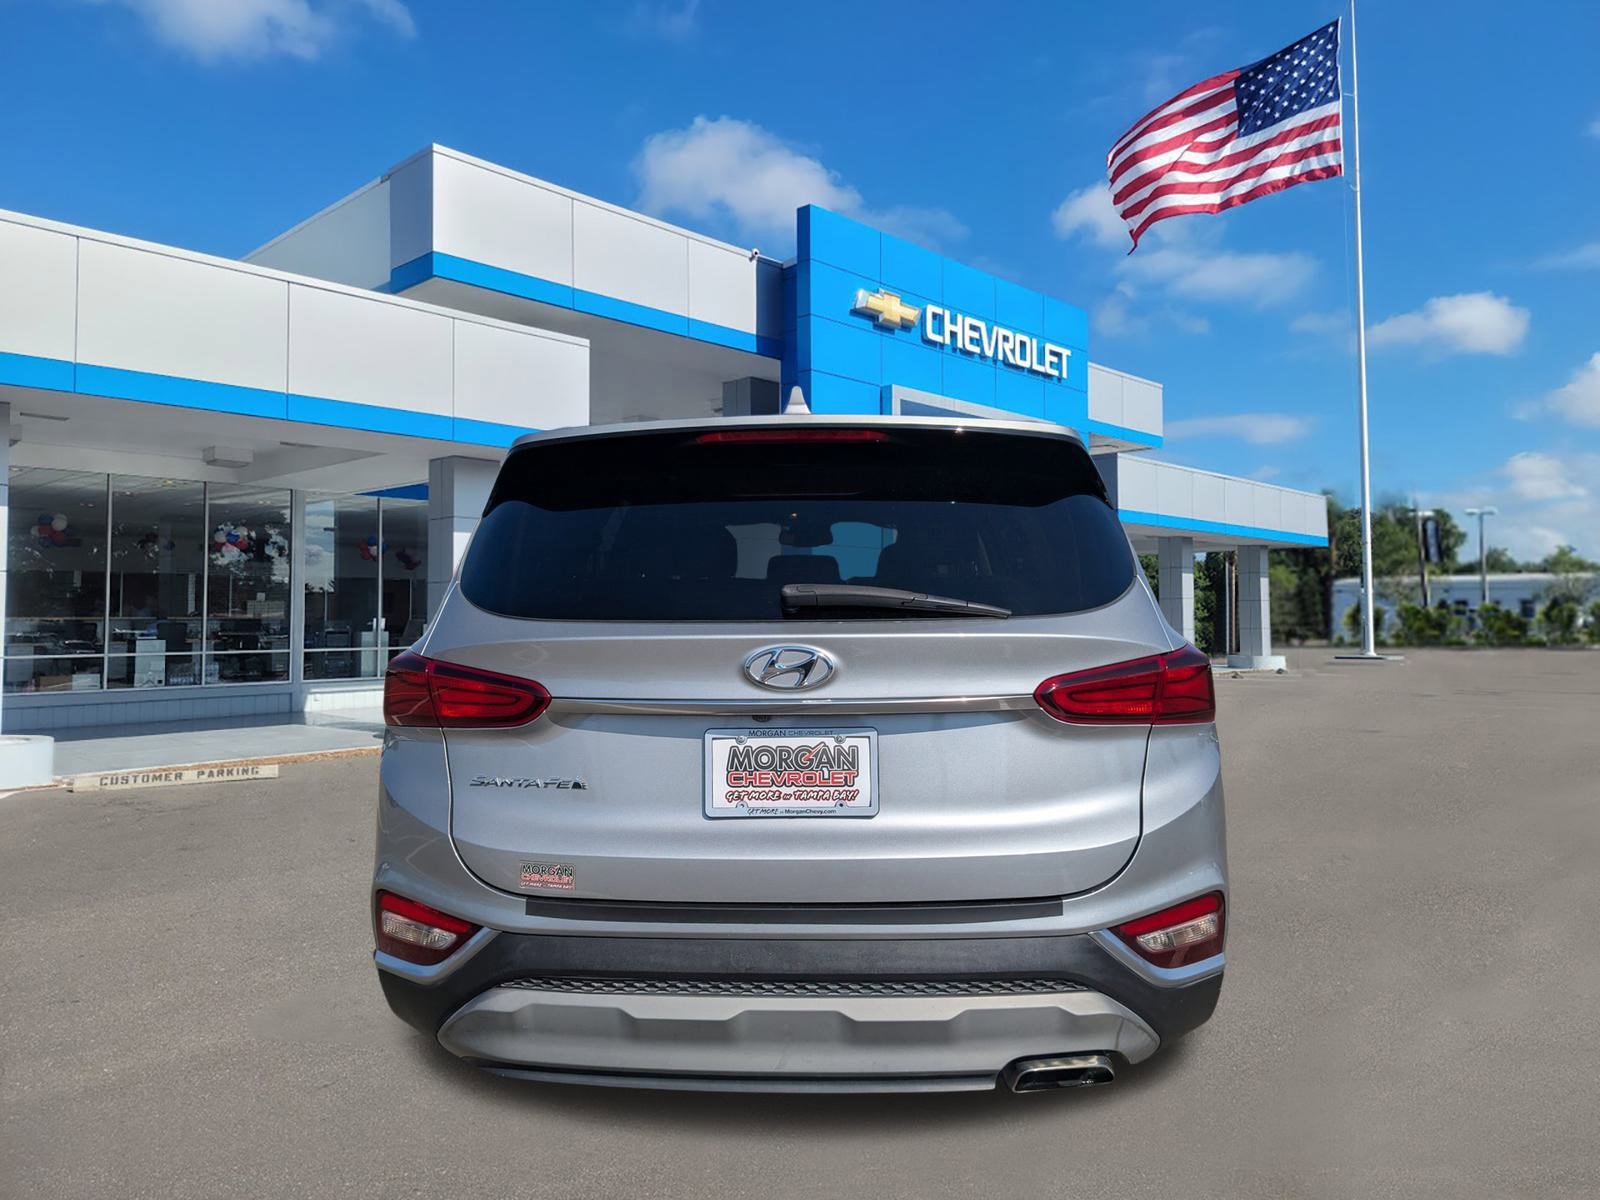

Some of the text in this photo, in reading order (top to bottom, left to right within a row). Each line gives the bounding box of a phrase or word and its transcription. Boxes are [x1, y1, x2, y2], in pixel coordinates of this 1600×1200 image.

[925, 304, 1072, 379] CHEVROLET
[728, 743, 858, 771] MORGAN
[99, 767, 259, 787] CUSTOMER PARKING
[469, 776, 572, 789] SANTA FE
[727, 771, 859, 787] CHEVROLET
[725, 790, 750, 803] GET
[750, 790, 781, 802] MORE
[793, 789, 830, 802] TAMPA
[831, 789, 860, 802] BAY!
[522, 863, 574, 877] MORGAN
